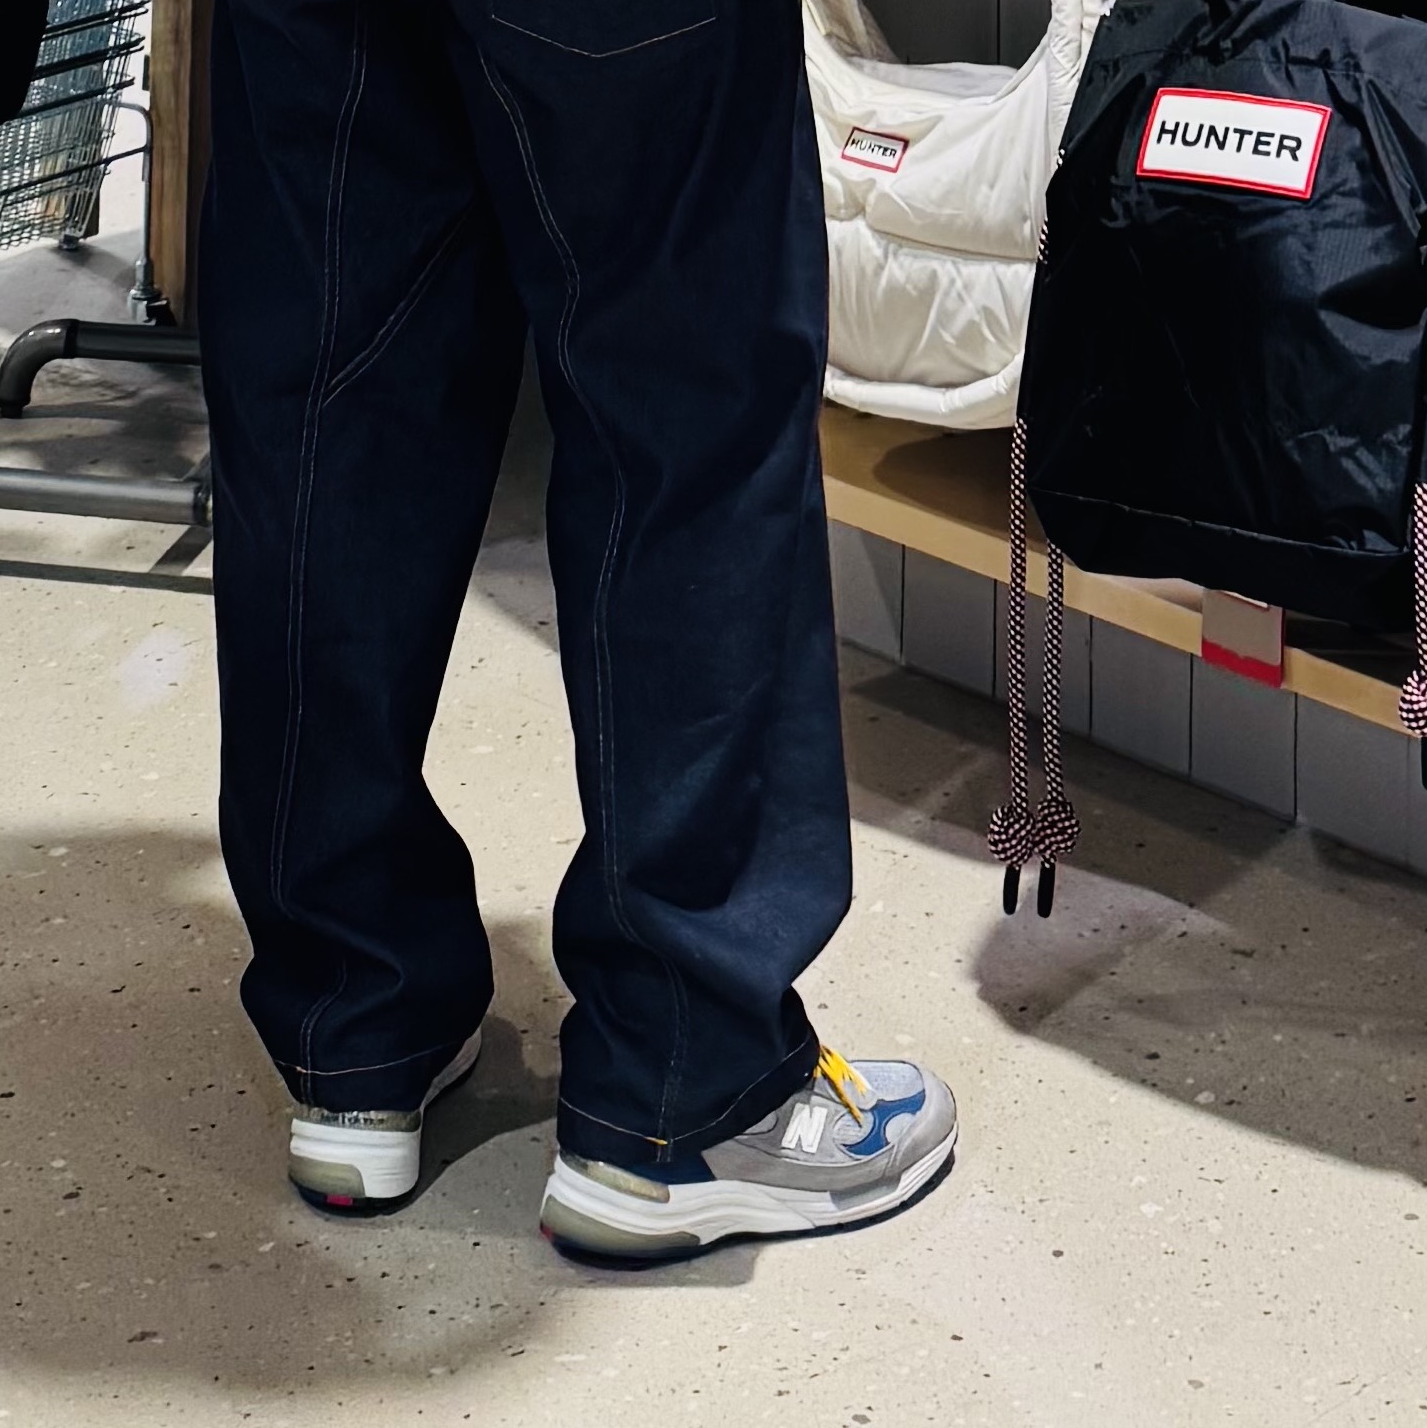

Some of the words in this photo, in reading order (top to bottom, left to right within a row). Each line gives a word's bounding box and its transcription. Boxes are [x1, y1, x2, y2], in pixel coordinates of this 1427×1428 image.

[851, 138, 899, 159] HUNTER
[1156, 120, 1302, 163] HUNTER
[781, 1105, 828, 1153] N
